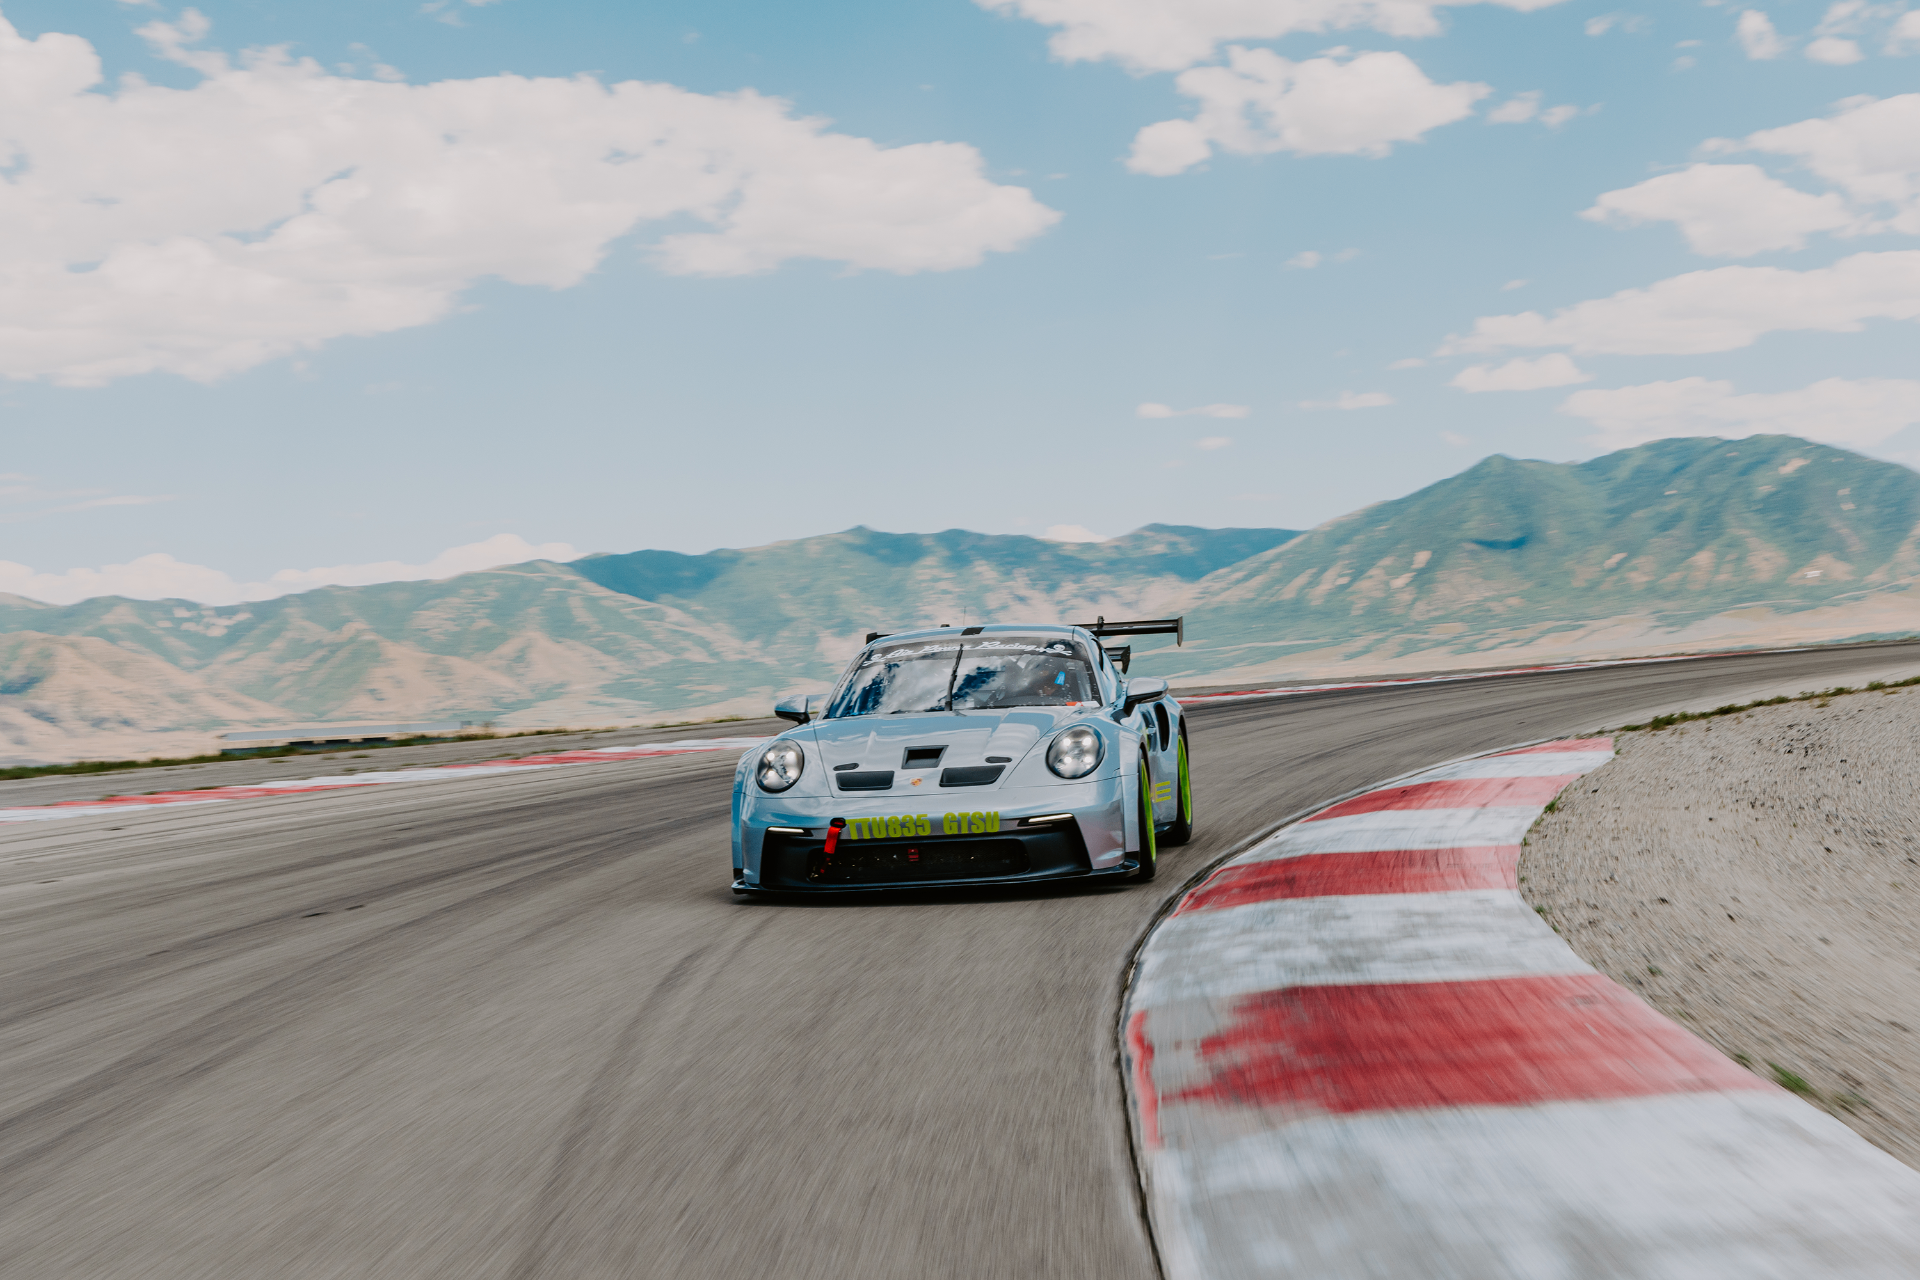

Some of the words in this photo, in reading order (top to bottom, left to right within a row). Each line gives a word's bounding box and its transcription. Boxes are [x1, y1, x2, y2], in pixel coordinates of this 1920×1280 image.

[977, 641, 1037, 651] Racing
[845, 814, 931, 840] TTU835
[943, 811, 1000, 834] GTSU
